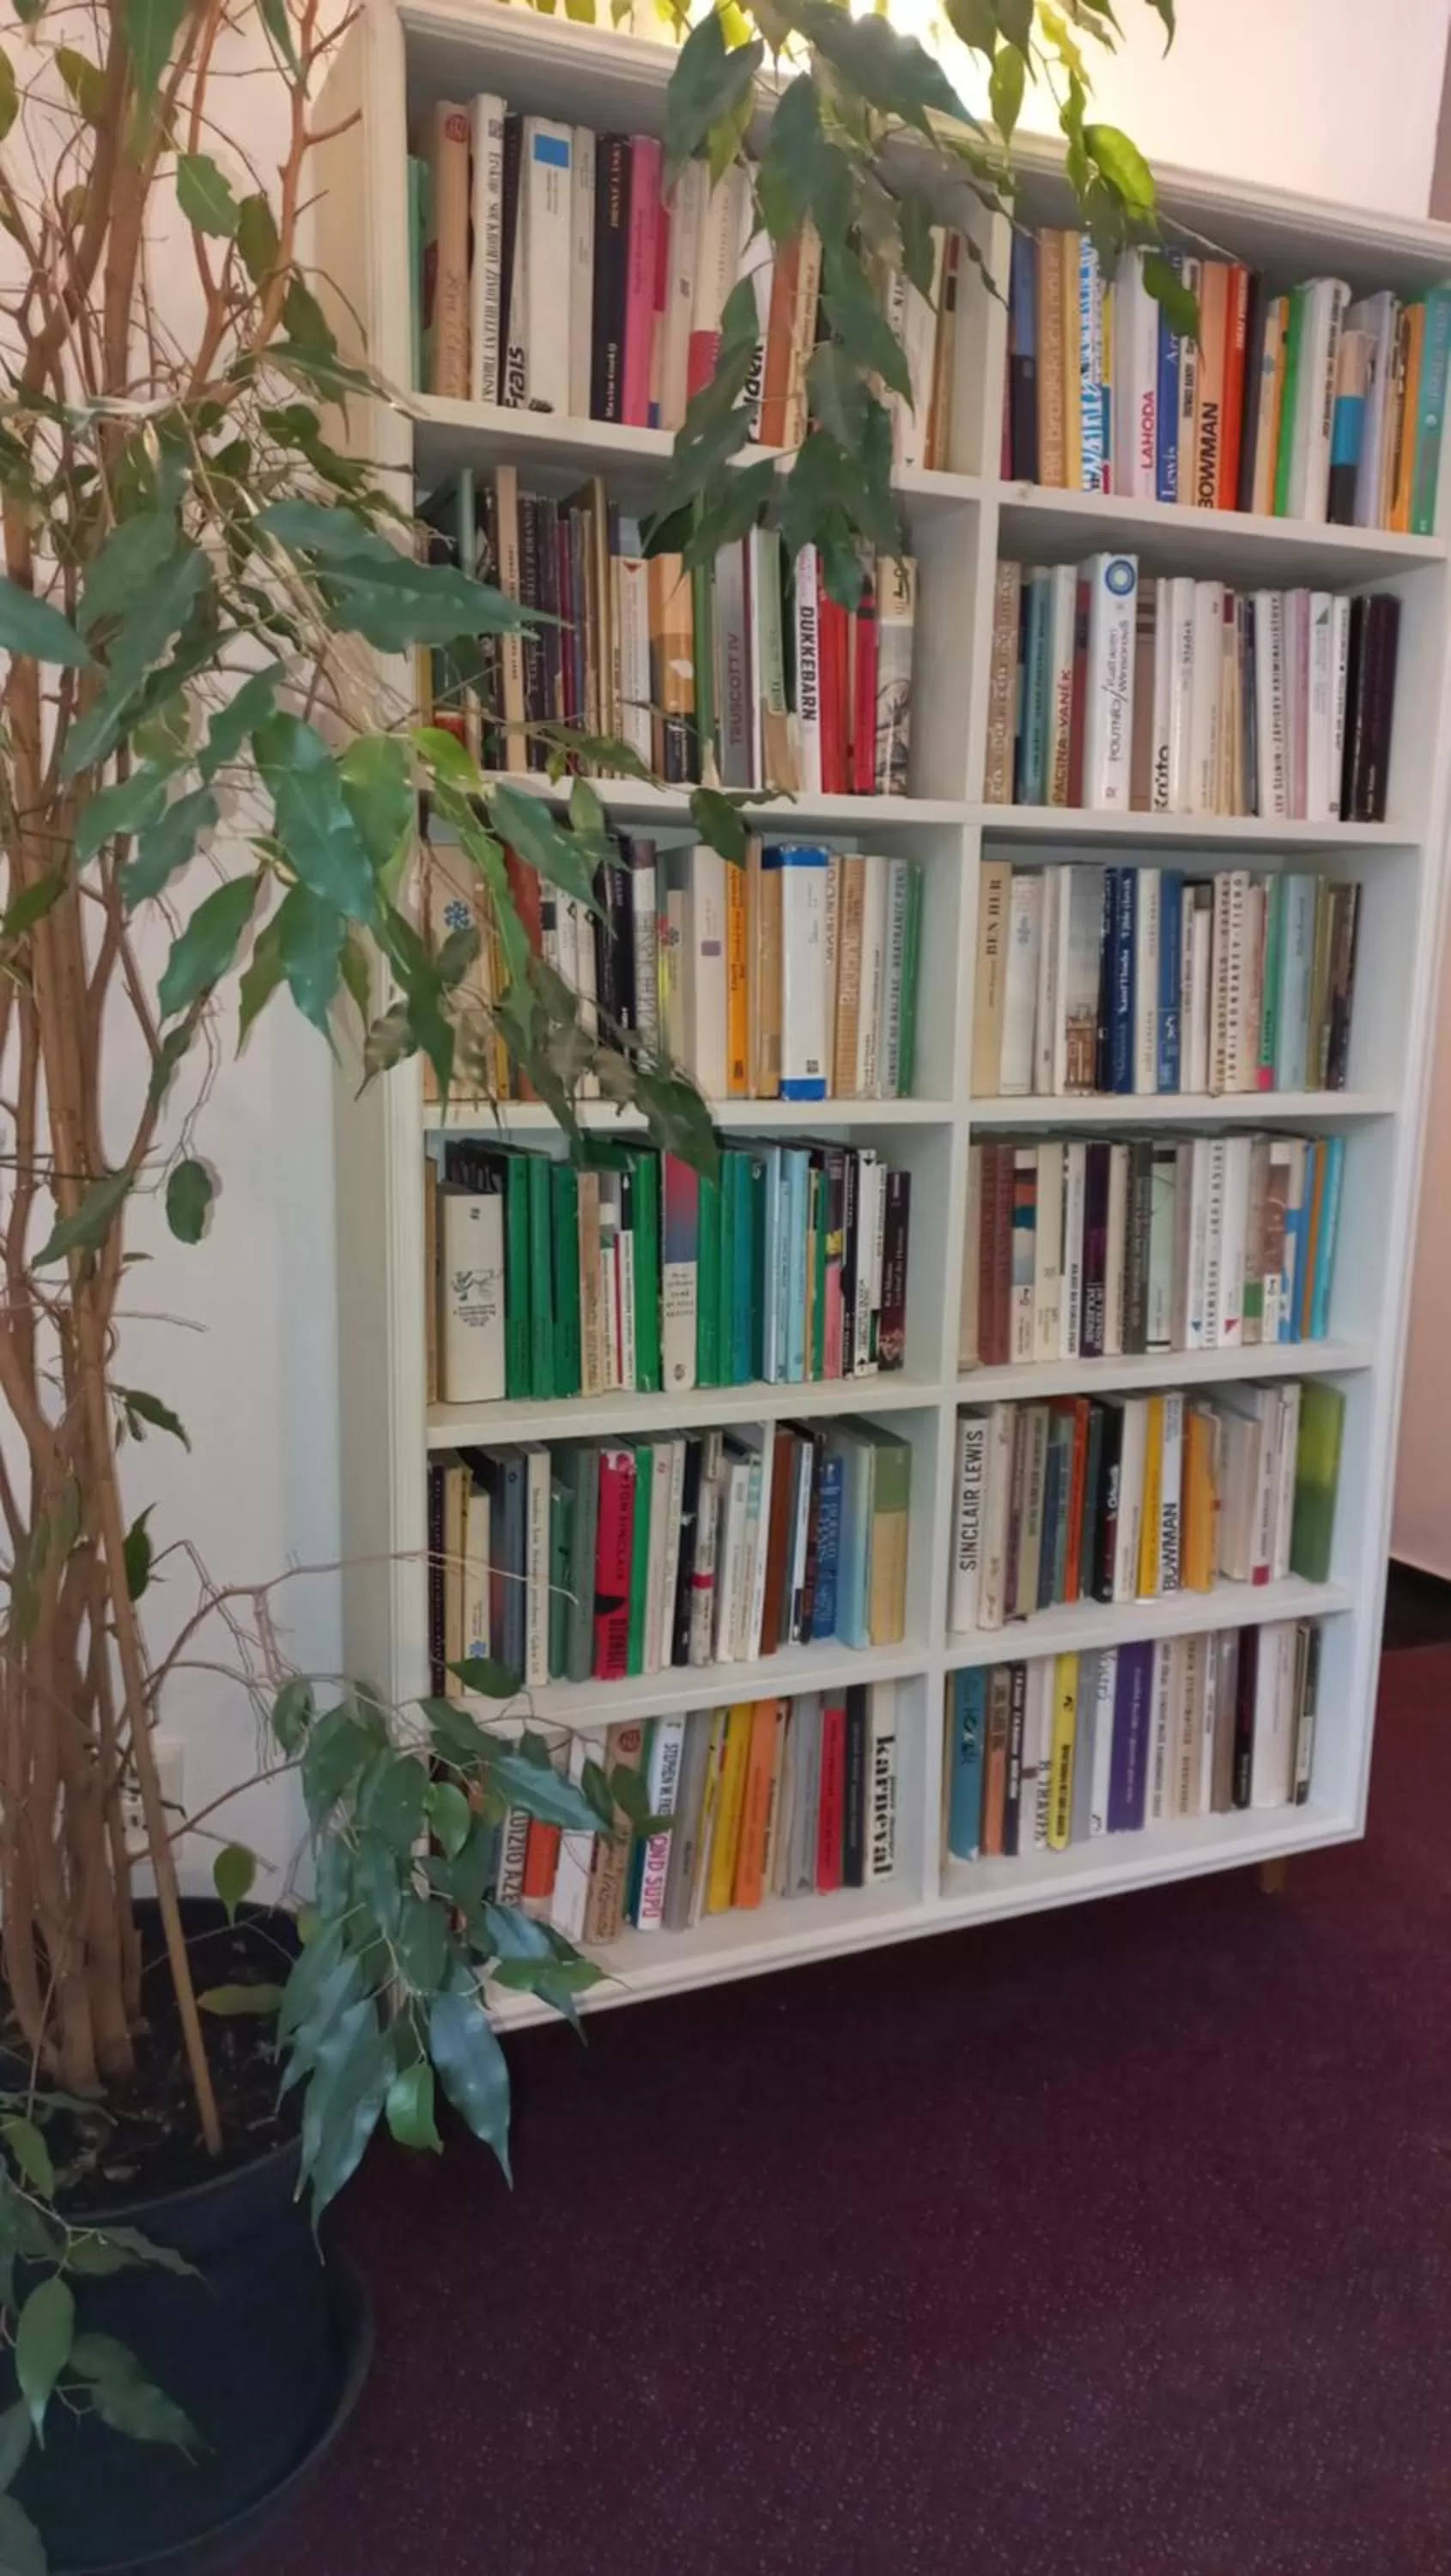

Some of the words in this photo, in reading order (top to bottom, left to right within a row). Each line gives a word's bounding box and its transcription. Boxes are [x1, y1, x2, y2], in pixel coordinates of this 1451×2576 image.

[1141, 391, 1156, 470] LAHODA
[1161, 446, 1177, 496] Lewis
[727, 632, 741, 651] IV
[800, 606, 817, 721] DUKKEBARN
[728, 657, 743, 747] TRUSCOTT
[987, 878, 1003, 915] HUR
[985, 920, 999, 956] BEN
[963, 1430, 984, 1483] LEWIS
[959, 1489, 980, 1571] SINCLAIR
[1162, 1502, 1178, 1591] BOWMAN
[873, 1735, 896, 1874] karneval
